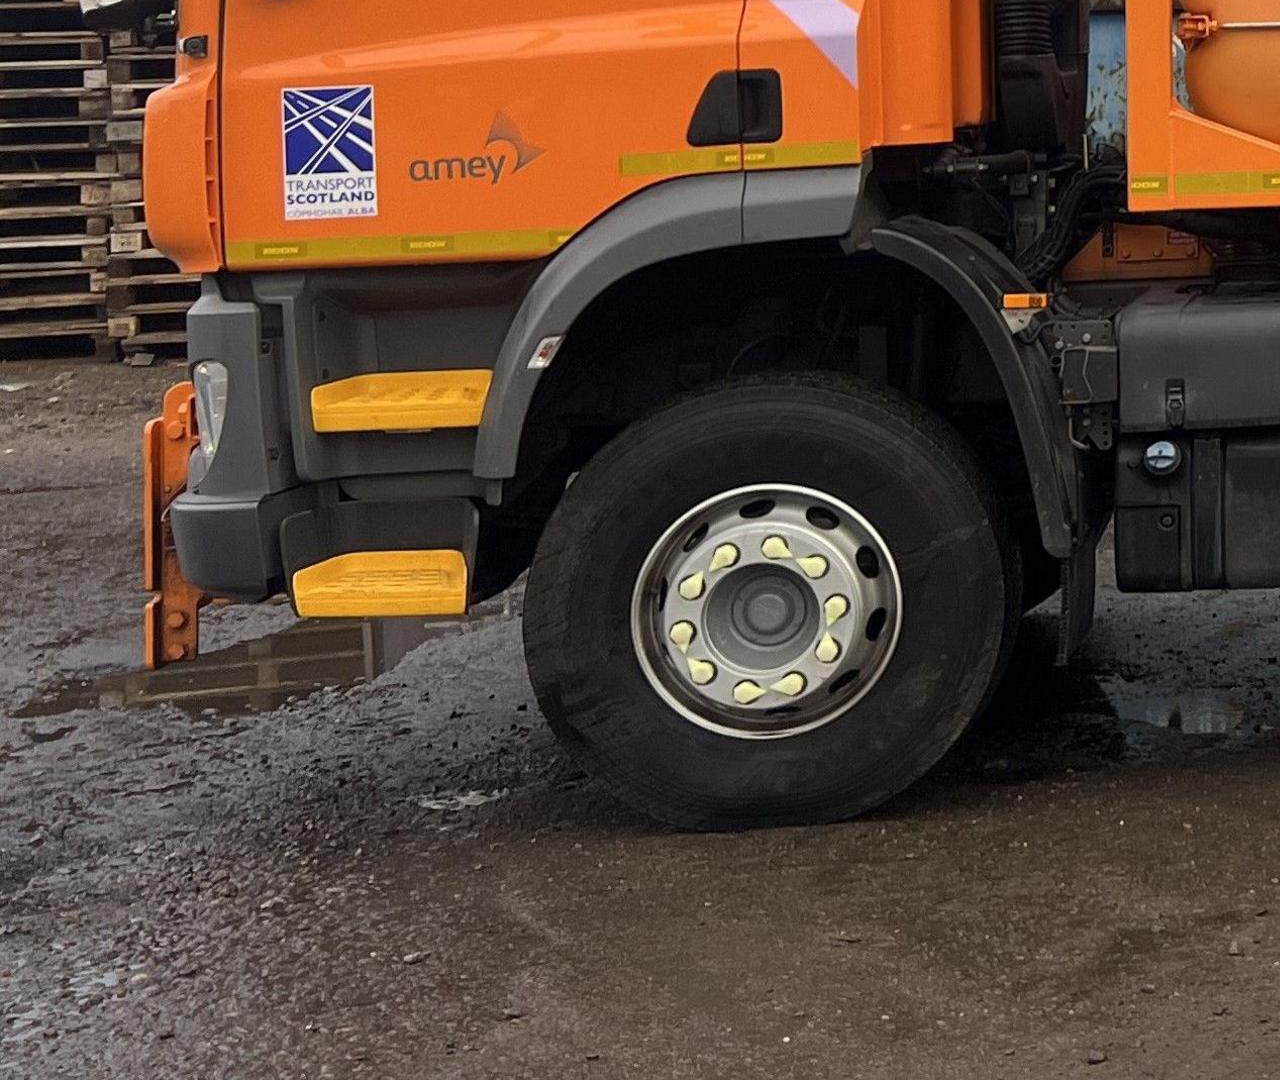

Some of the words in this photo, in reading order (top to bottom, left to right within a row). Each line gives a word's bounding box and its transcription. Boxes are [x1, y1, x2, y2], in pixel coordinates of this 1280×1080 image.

[409, 154, 505, 185] amey
[286, 176, 374, 192] TRANSPORT
[286, 190, 375, 205] SCOTLAND
[347, 206, 375, 216] ALBA
